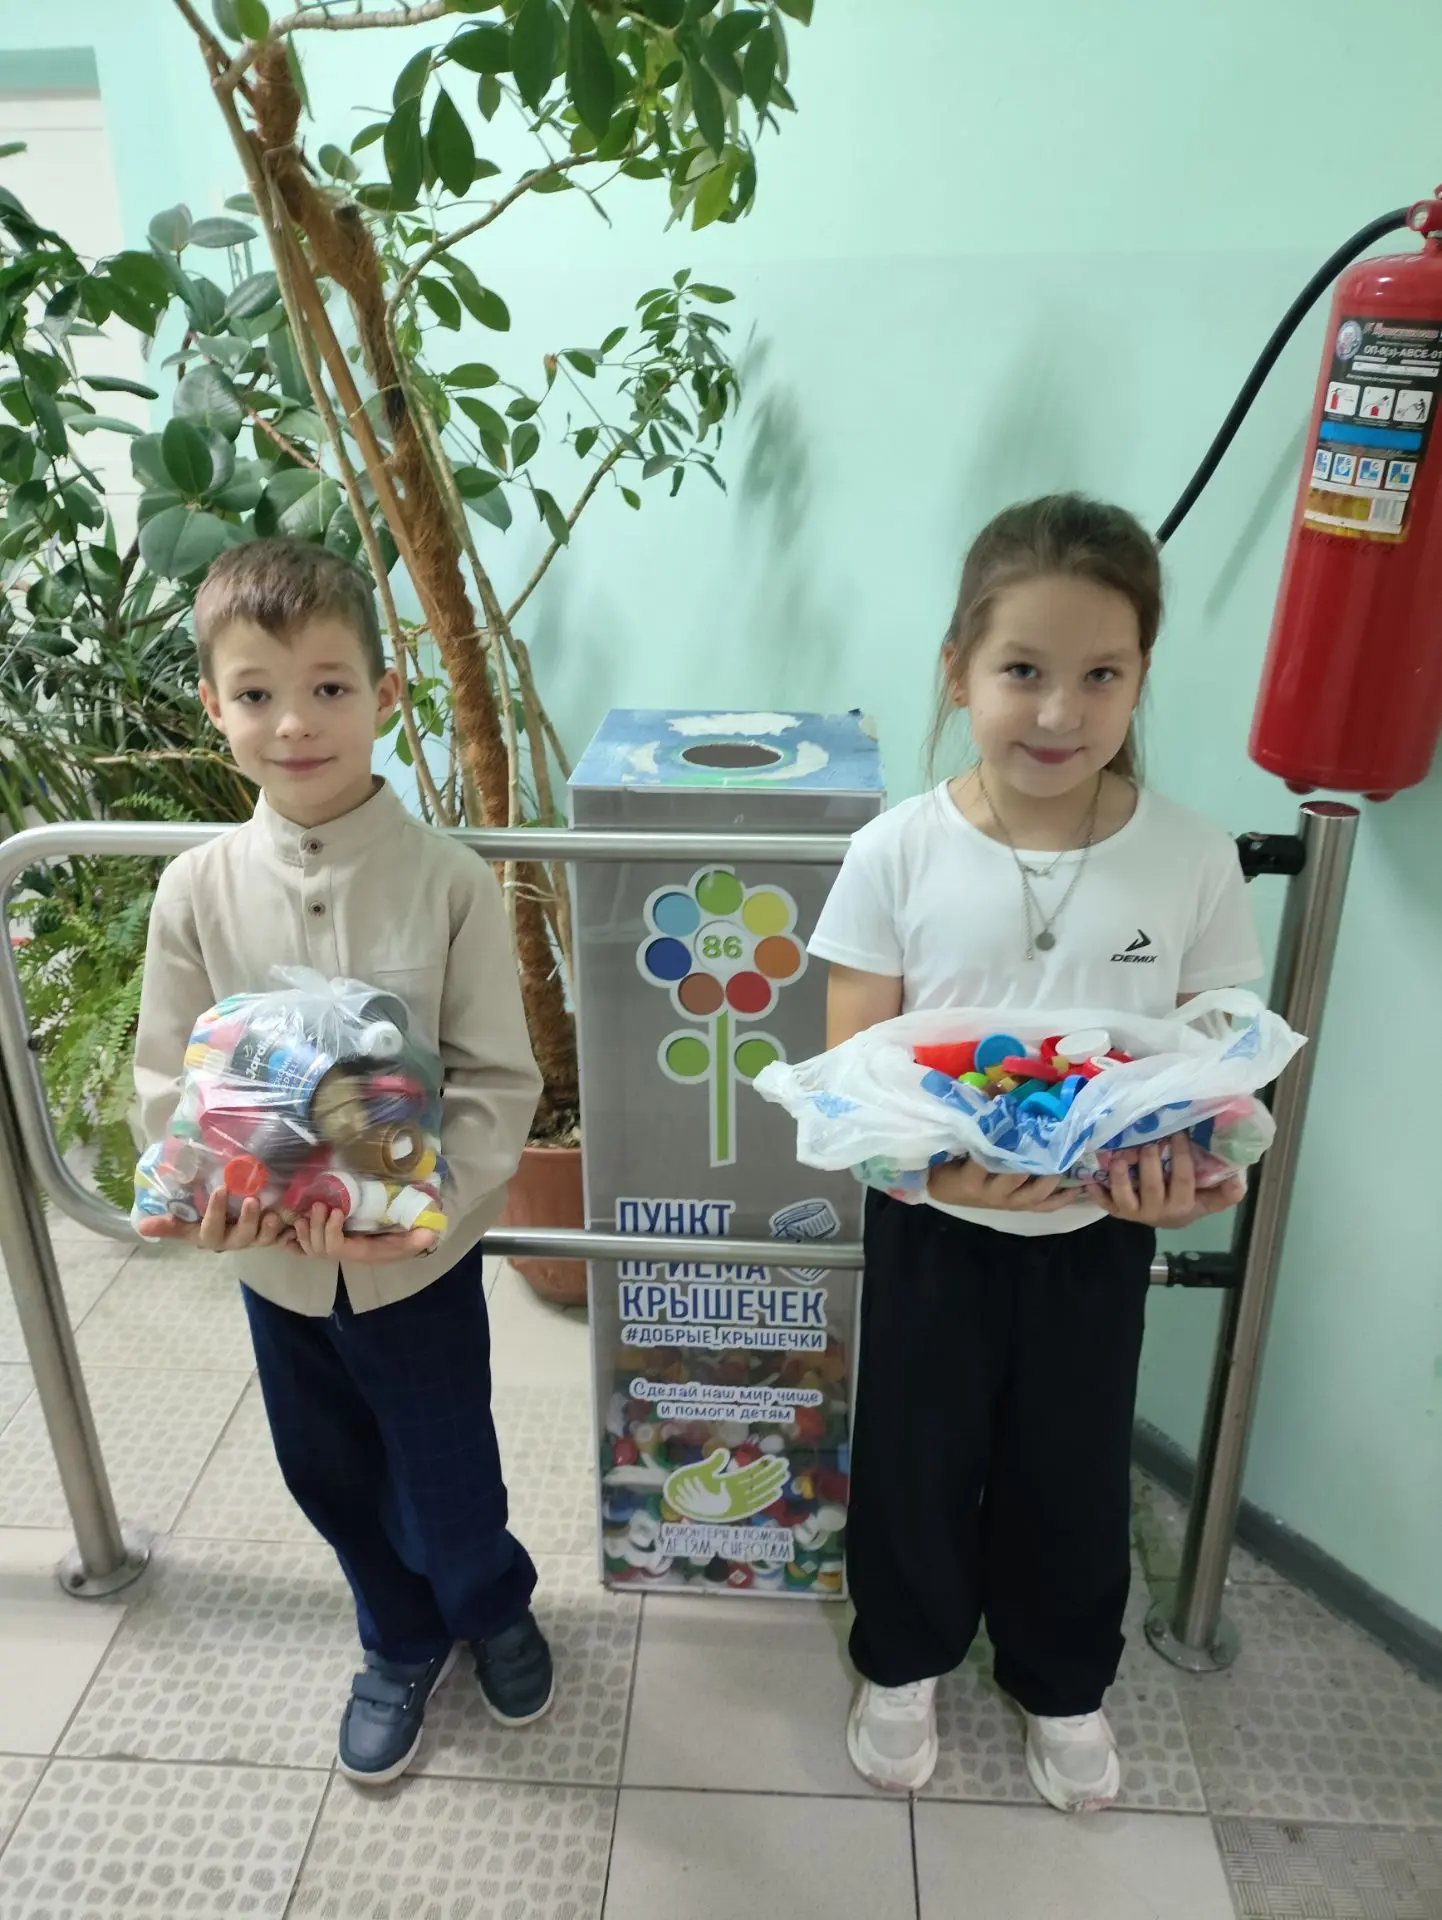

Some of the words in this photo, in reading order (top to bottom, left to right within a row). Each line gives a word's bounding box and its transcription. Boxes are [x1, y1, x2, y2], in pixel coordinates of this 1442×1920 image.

[702, 935, 743, 959] 86
[1110, 954, 1159, 963] DEMIX
[620, 1201, 731, 1236] ПУНКТ
[623, 1285, 824, 1324] КРЫШЕЧЕК
[625, 1327, 823, 1347] #ДОБРЫЕ_КРЫШЕЧКИ
[633, 1381, 698, 1398] Сделай
[702, 1389, 735, 1399] наш
[739, 1390, 773, 1405] мир
[777, 1391, 819, 1405] чище
[661, 1406, 671, 1416] и
[675, 1407, 735, 1417] помоги
[740, 1409, 791, 1421] детям
